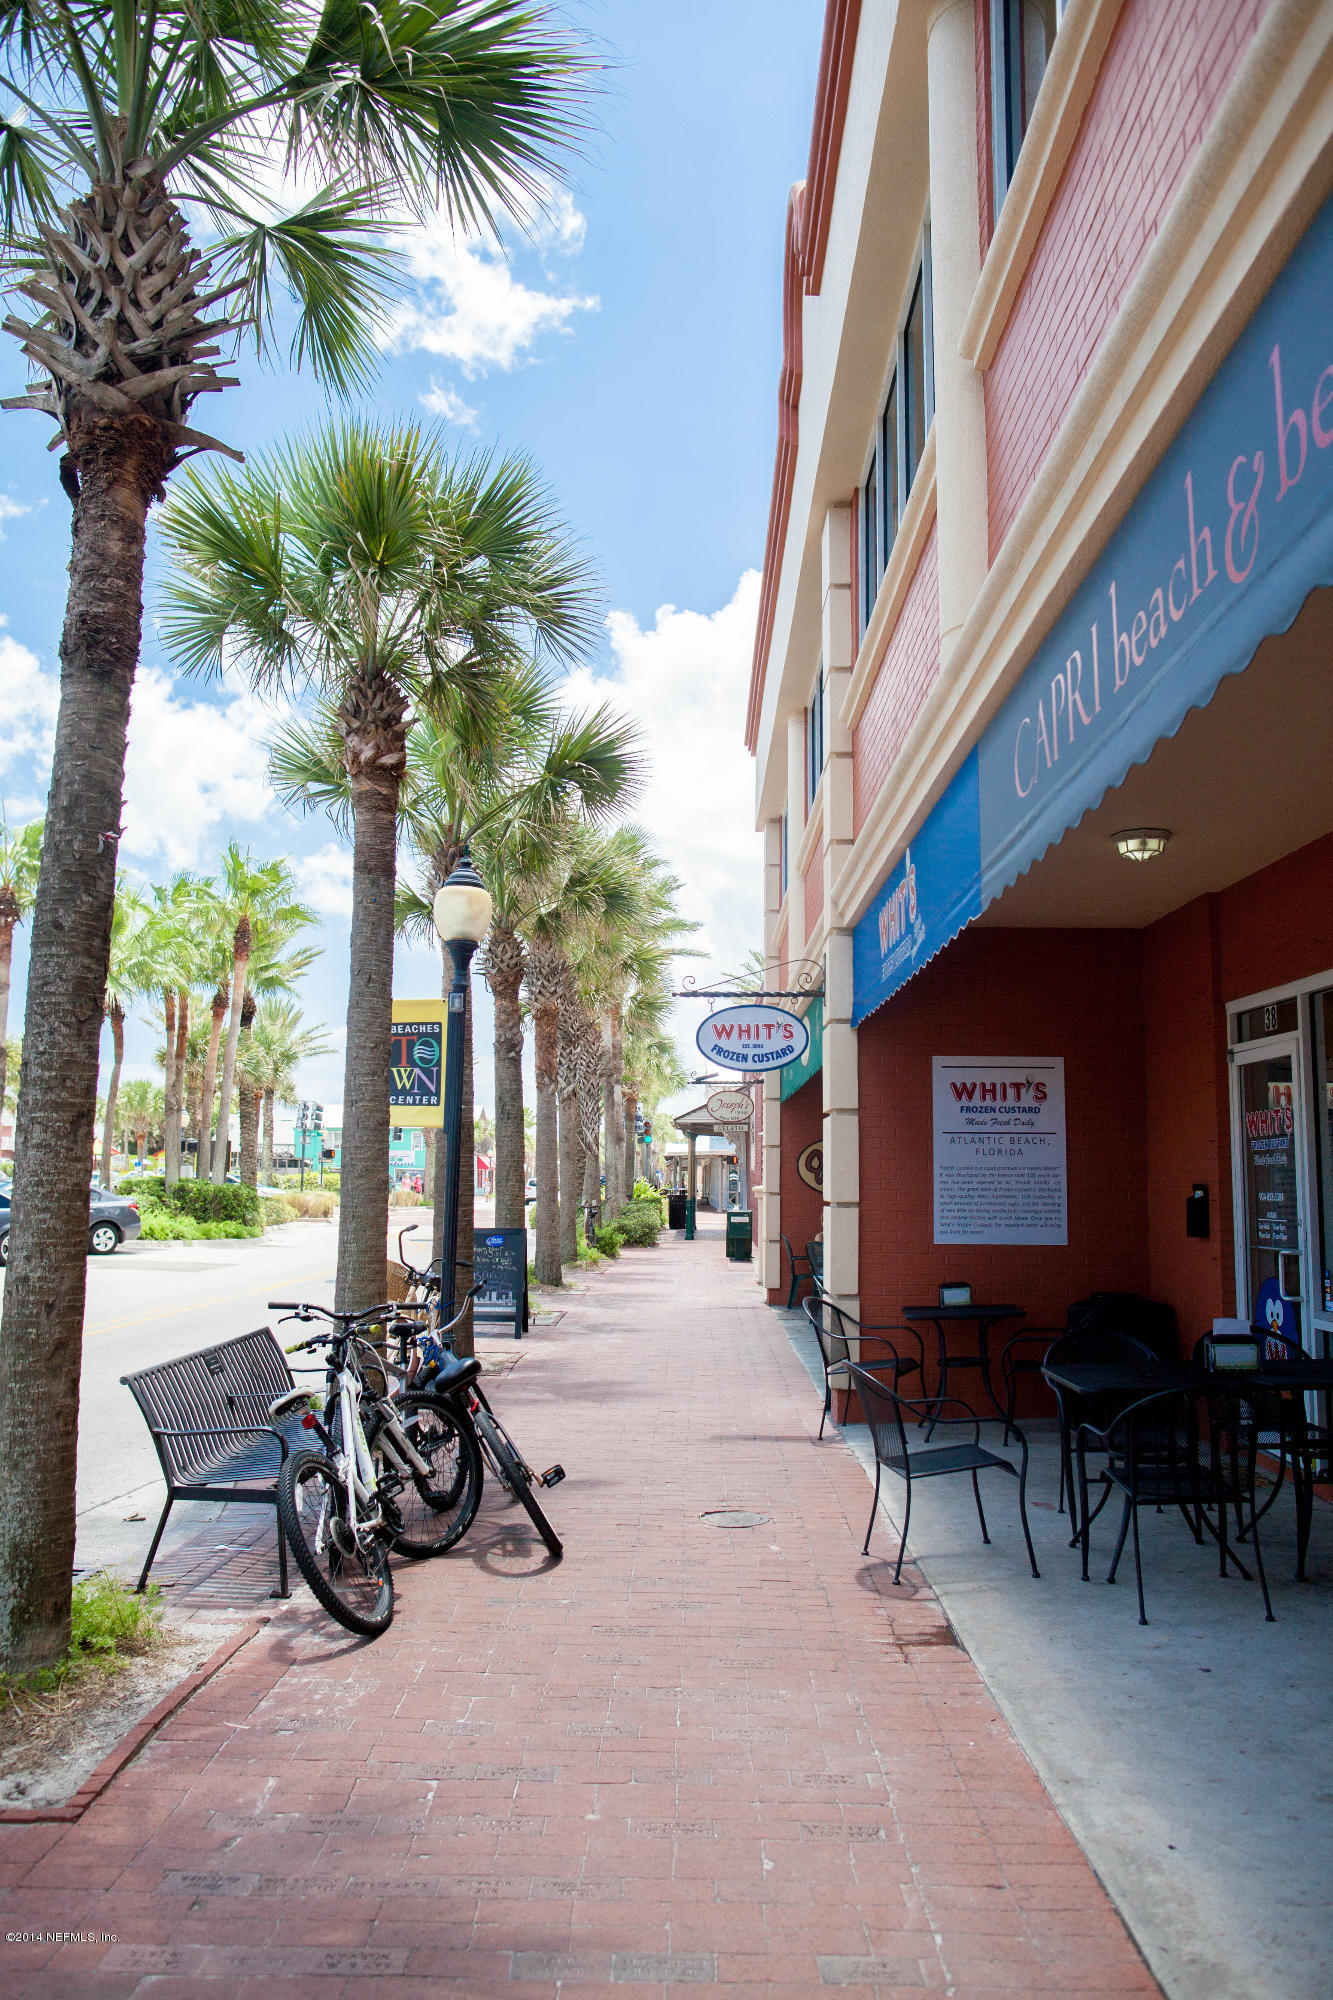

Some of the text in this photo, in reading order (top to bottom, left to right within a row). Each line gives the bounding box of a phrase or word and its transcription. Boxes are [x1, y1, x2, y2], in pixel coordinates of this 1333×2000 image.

[1014, 620, 1101, 798] CAPRI
[1107, 469, 1218, 694] beach
[1224, 450, 1265, 584] &
[1265, 1006, 1277, 1030] 38
[391, 1024, 440, 1034] BEACHES
[711, 1022, 794, 1041] WHIT'S
[710, 1043, 795, 1063] FROZEN CUSTARD
[949, 1080, 1048, 1103] WHIT'S
[389, 1095, 438, 1105] CENTER
[711, 1096, 750, 1114] Joseph's
[960, 1105, 1042, 1114] FROZEN CUSTARD
[965, 1117, 1036, 1128] Made Fresh Daily
[949, 1136, 1051, 1146] ATLANTIC BEACH,
[975, 1148, 1024, 1156] FLORIDA
